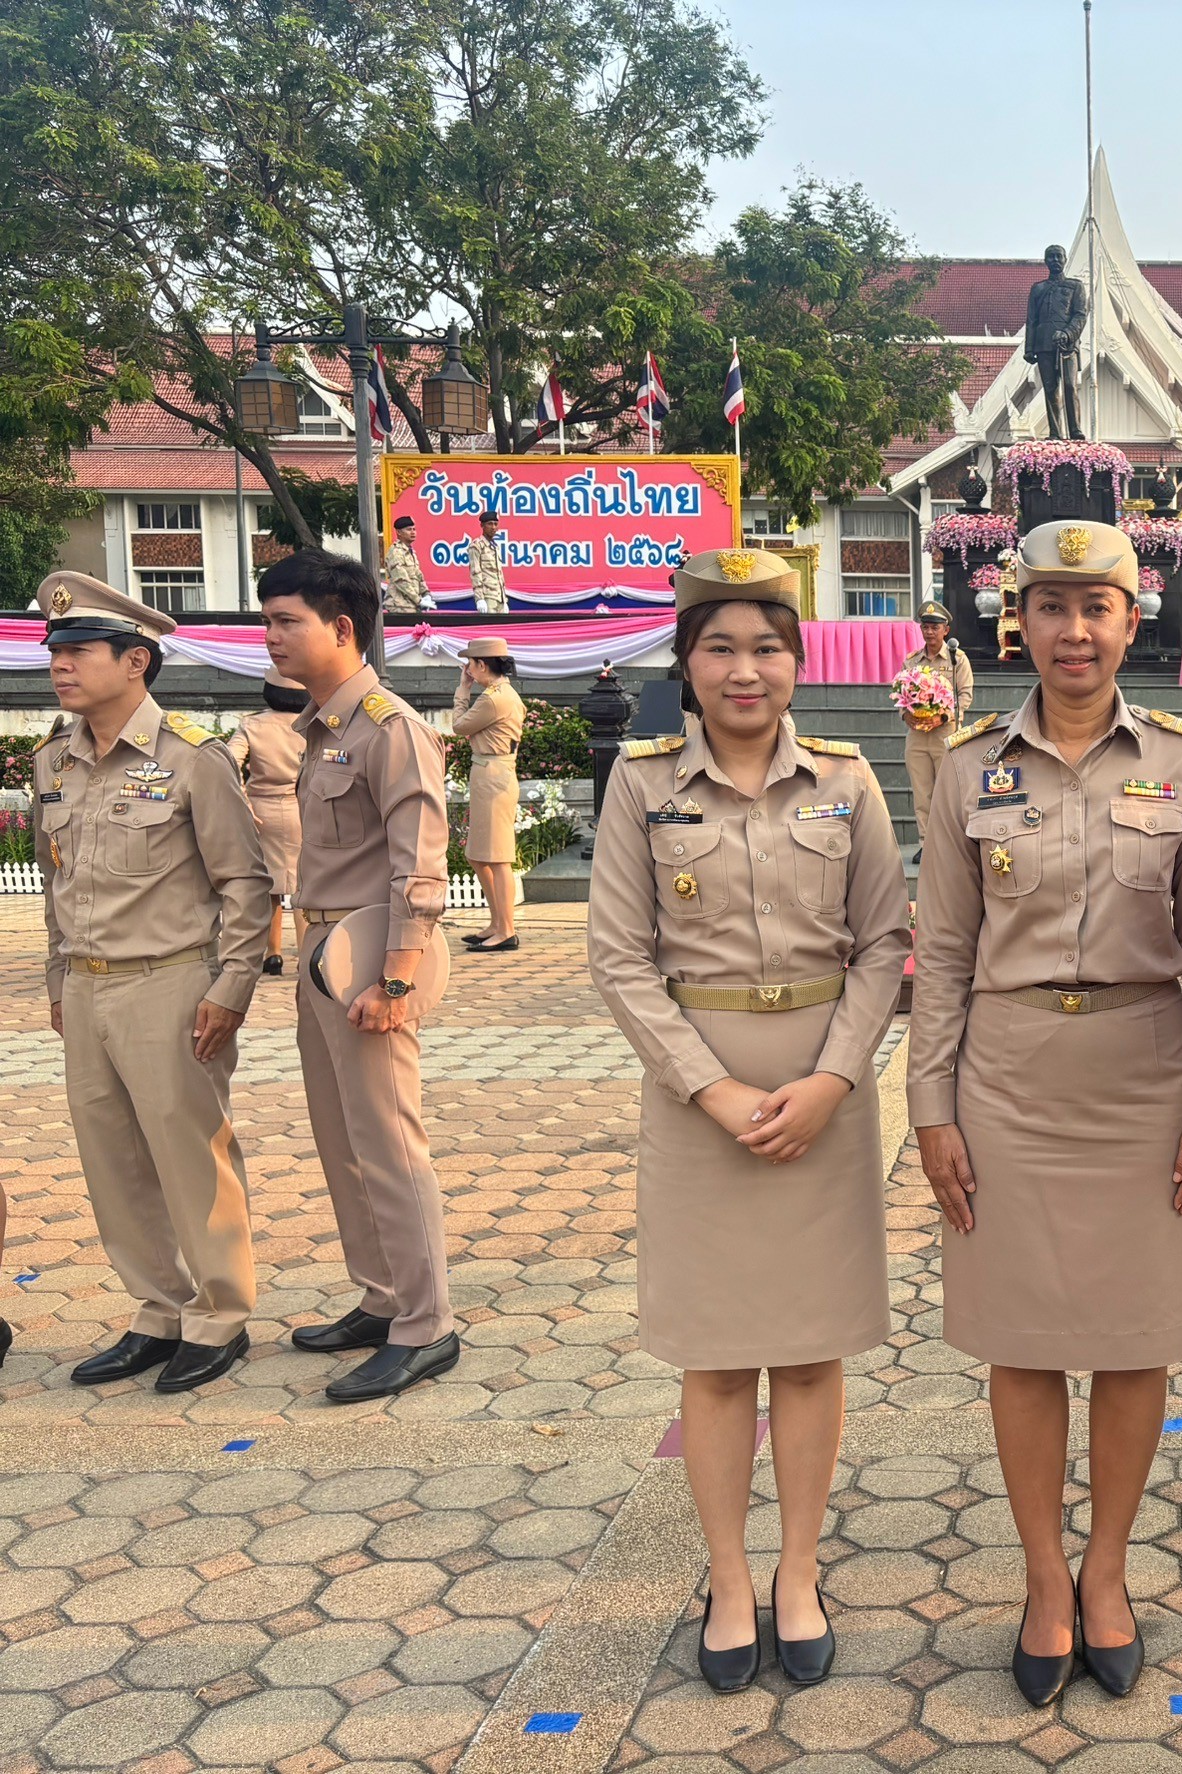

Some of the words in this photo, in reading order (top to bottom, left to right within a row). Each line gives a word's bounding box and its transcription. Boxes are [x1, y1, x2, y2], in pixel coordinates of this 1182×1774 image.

[420, 468, 700, 515] วันท้องถิ่นไทย
[493, 530, 591, 565] ีนาคม
[607, 536, 683, 566] ๒๕๖๘
